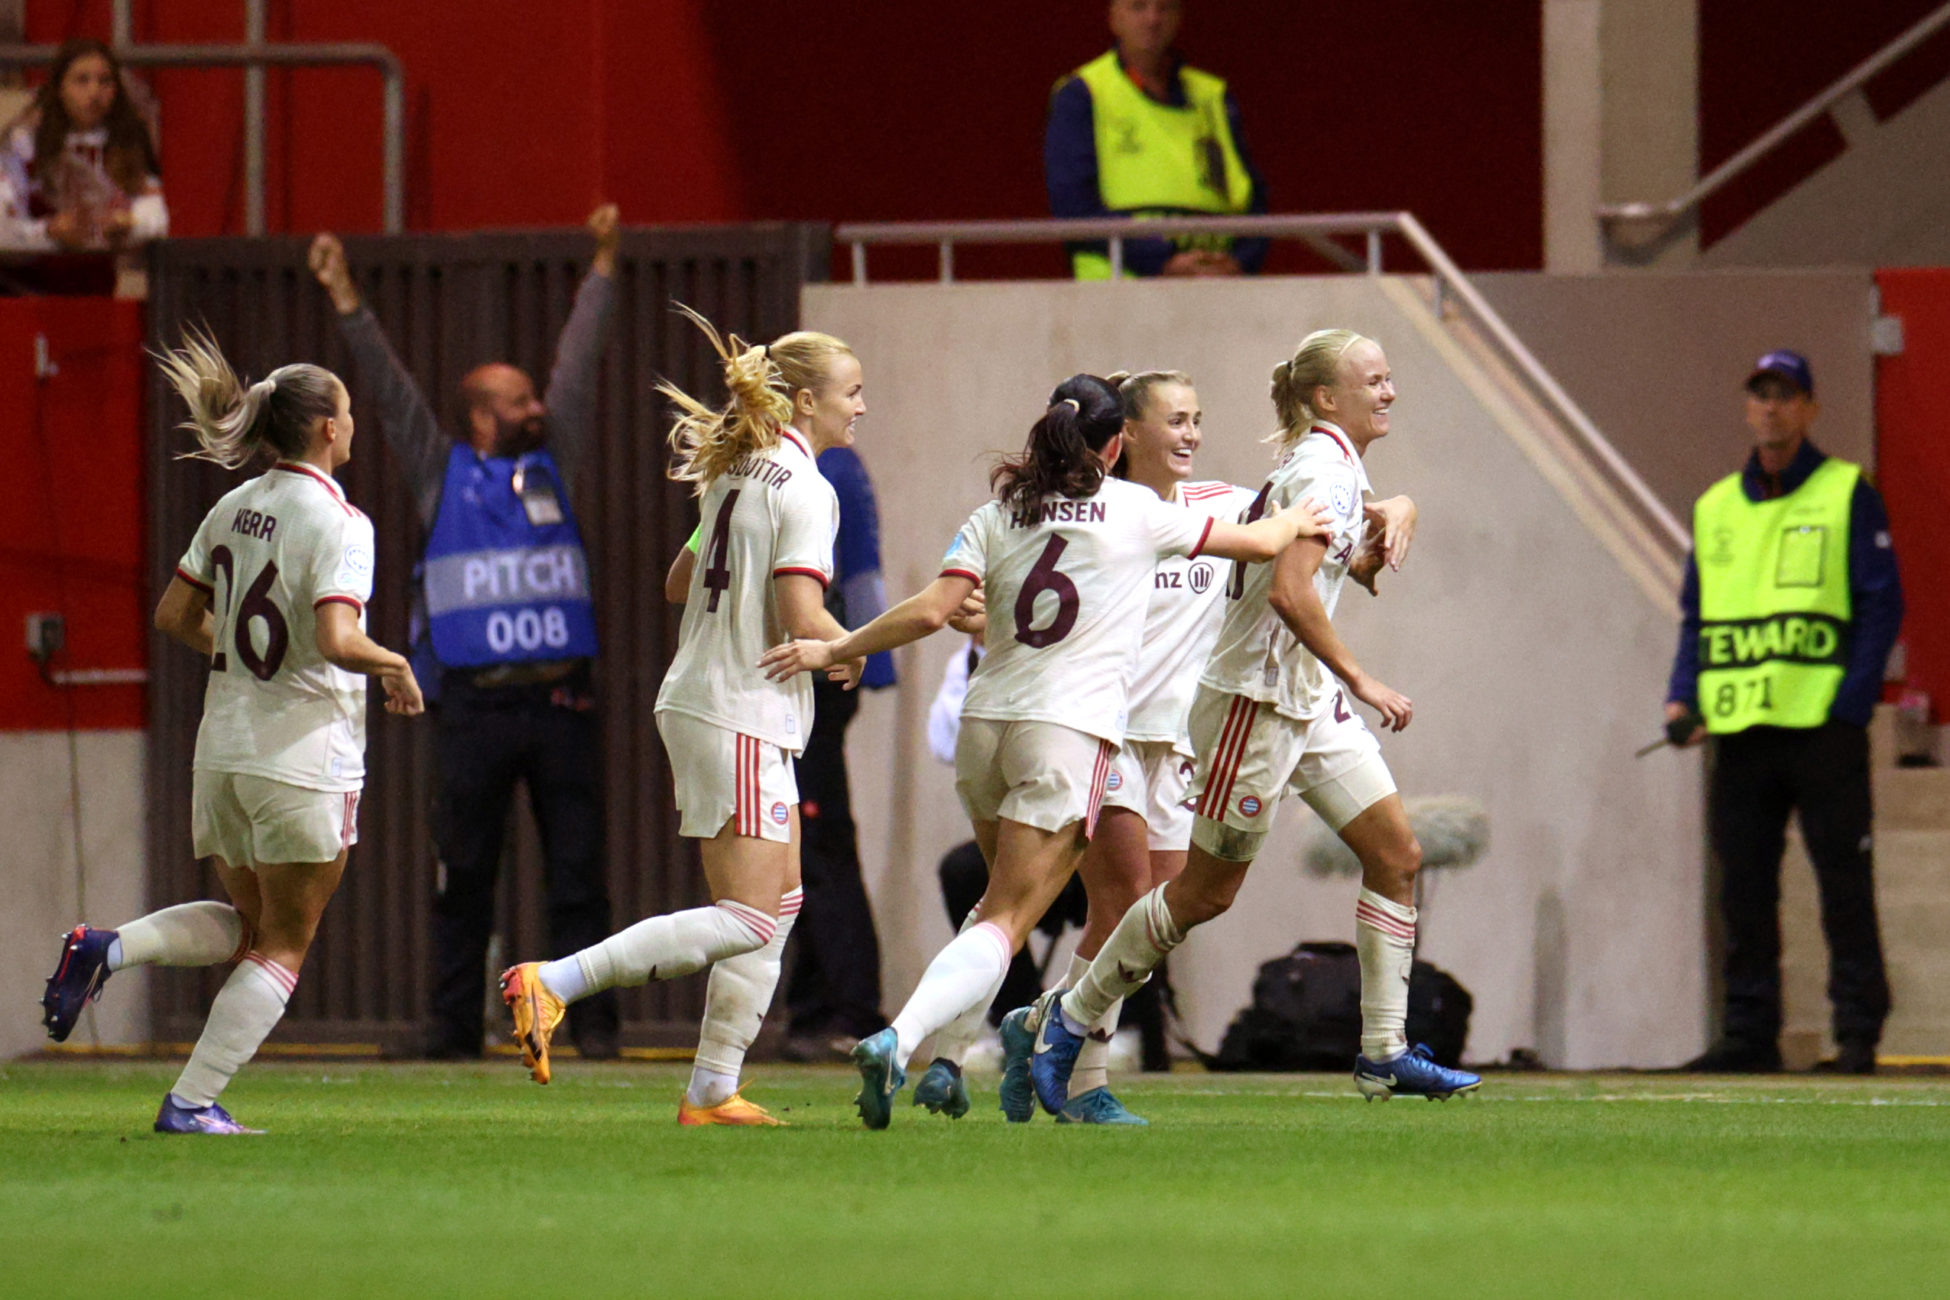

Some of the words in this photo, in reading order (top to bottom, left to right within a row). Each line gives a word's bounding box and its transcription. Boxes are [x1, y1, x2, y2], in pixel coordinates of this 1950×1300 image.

[231, 508, 277, 542] KERR
[1009, 501, 1106, 530] HNSEN
[464, 552, 577, 598] PITCH
[704, 489, 741, 613] 4
[211, 544, 289, 681] 26
[1014, 532, 1080, 649] 6
[486, 606, 569, 654] 008
[1699, 617, 1838, 665] TEWARD
[1715, 677, 1771, 718] 871
